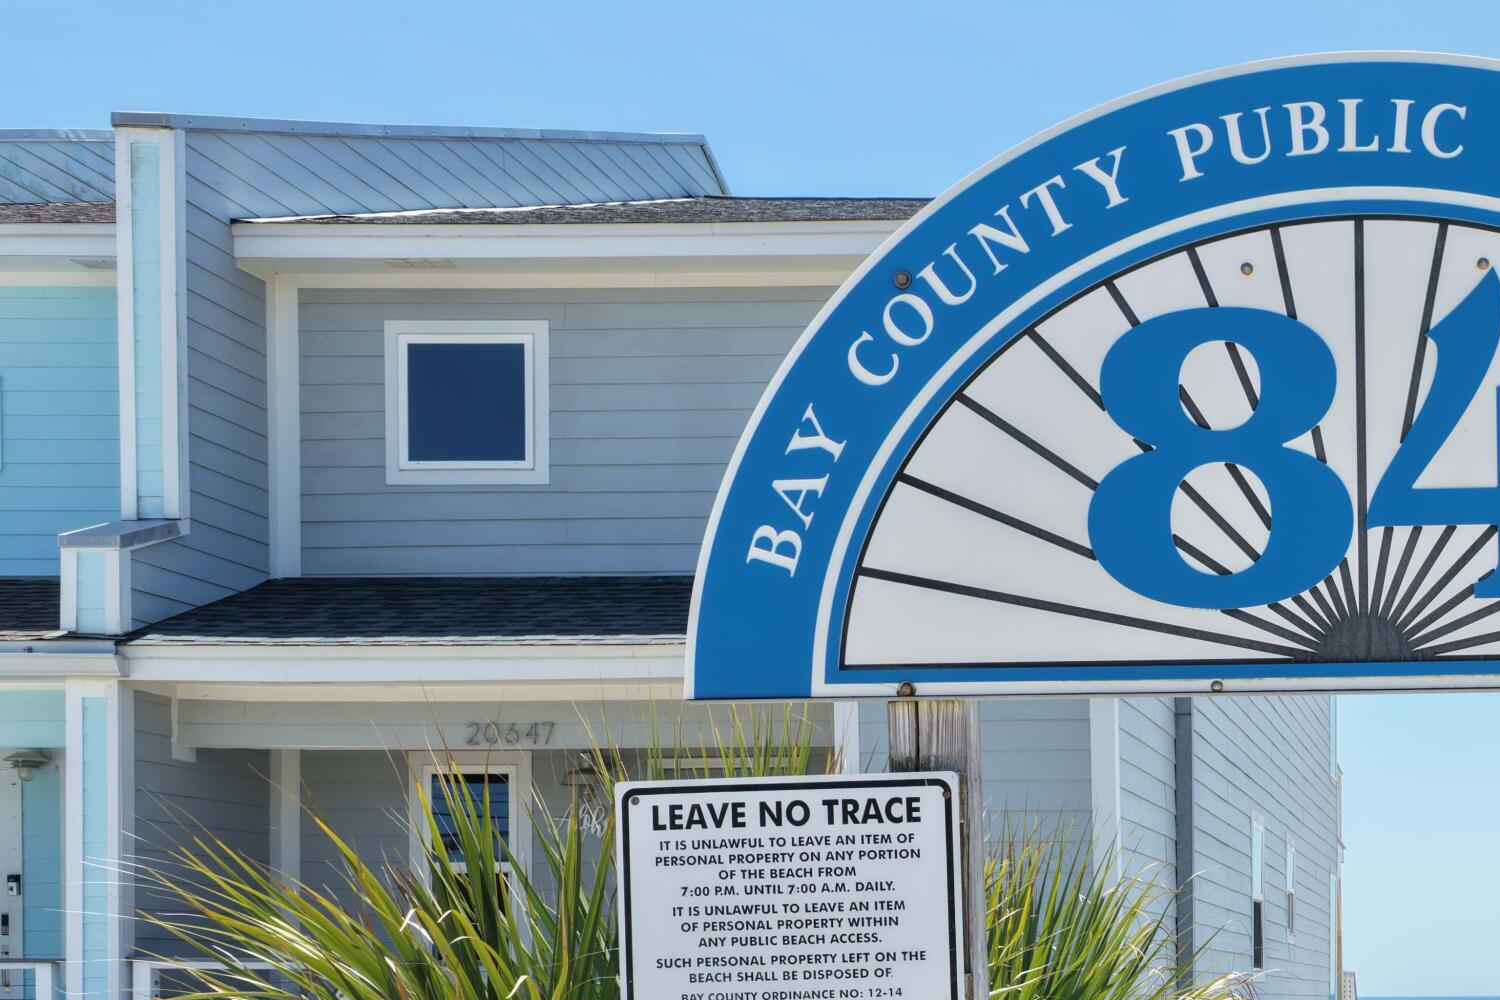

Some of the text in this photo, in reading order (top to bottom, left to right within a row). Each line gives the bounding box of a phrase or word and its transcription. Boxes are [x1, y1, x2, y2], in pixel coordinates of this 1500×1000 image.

[746, 403, 847, 577] BAY
[848, 146, 1129, 386] COUNTY
[1167, 99, 1468, 182] PUBLIC
[466, 721, 556, 746] 20647
[652, 797, 921, 831] LEAVE NO TRACE
[660, 833, 915, 851] IT IS UNLAWFUL TO LEAVE AN ITEM OF
[655, 848, 920, 867] PERSONAL PROPERTY ON ANY PORTION
[718, 866, 856, 880] OF THE BEACH FROM
[681, 881, 895, 897] 7:00 P.M. UNTIL 7:00 A.M. DAILY.
[673, 900, 905, 917] IT IS UNLAWFUL TO LEAVE AN ITEM
[681, 916, 899, 933] OF PERSONAL PROPERTY WITHIN
[698, 932, 882, 948] ANY PUBLIC BEACH ACCESS.
[656, 950, 926, 969] SUCH PERSONAL PROPERTY LEFT ON THE
[689, 972, 732, 983] BEACH
[737, 971, 778, 982] SHALL
[783, 970, 798, 981] BE
[803, 968, 869, 980] DISPOSED
[762, 989, 835, 1000] ORDINANCE
[839, 989, 863, 998] NO:
[869, 987, 903, 997] 12-14
